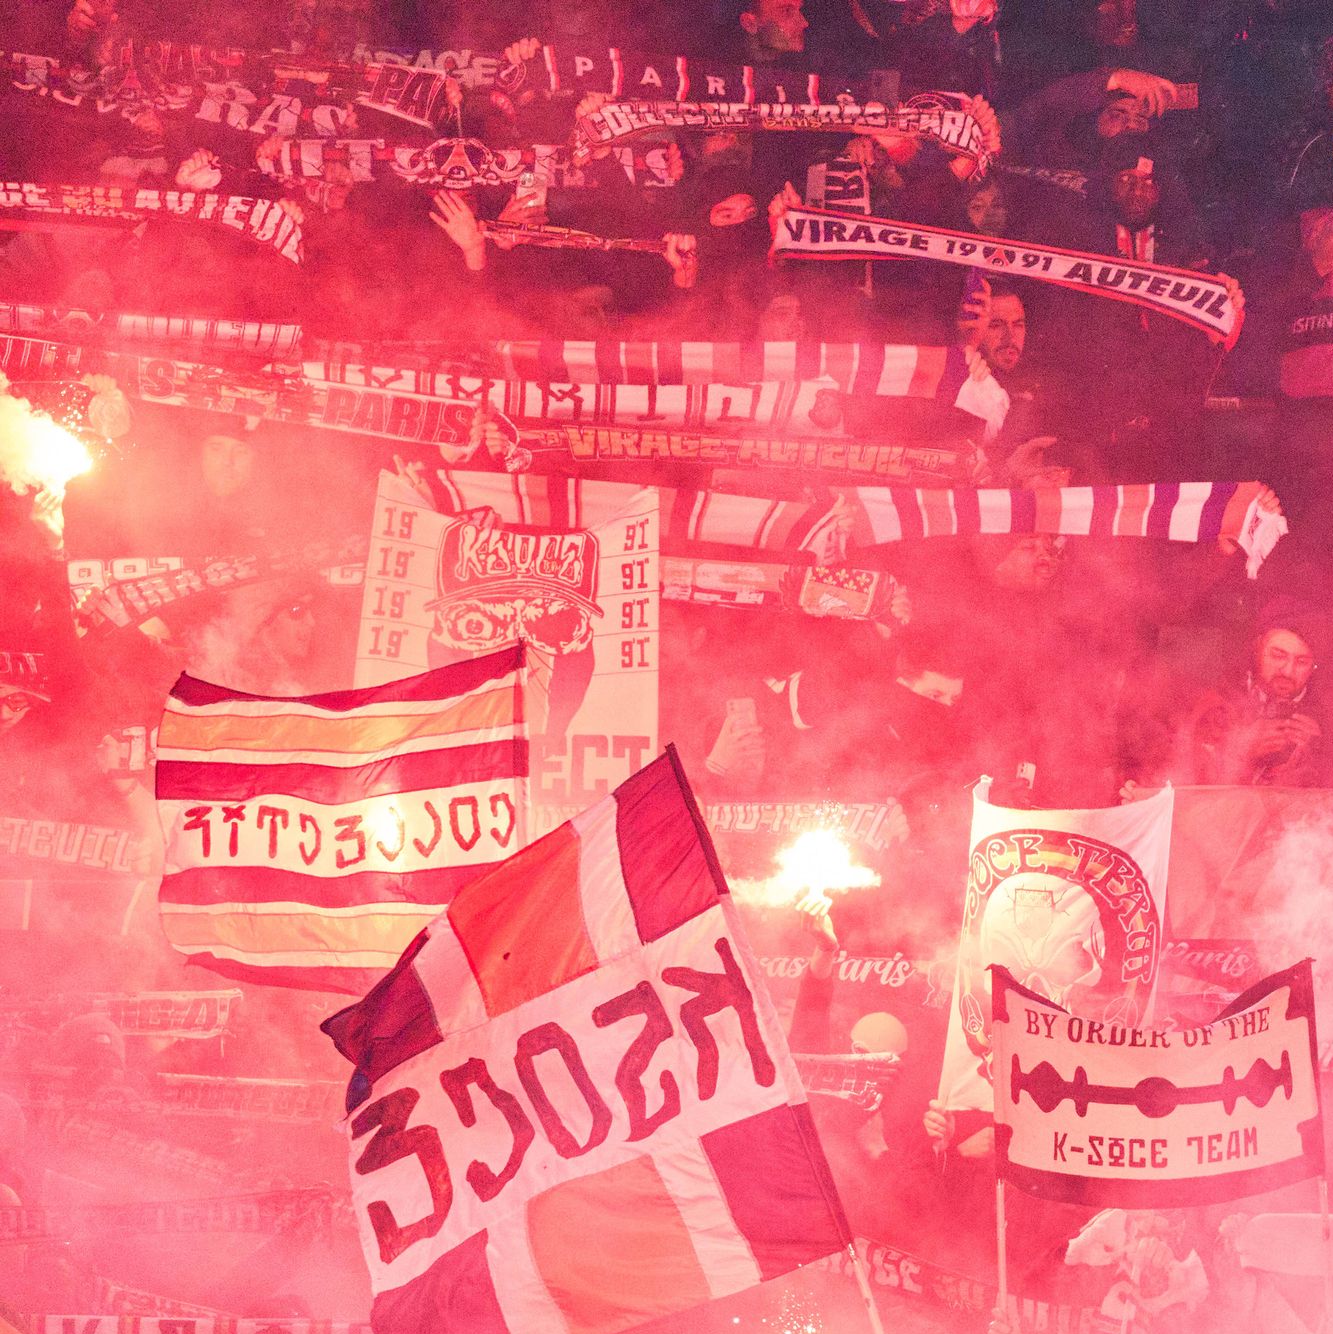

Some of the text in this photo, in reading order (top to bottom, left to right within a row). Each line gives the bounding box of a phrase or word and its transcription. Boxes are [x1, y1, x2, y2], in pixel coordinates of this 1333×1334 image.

[786, 209, 1230, 320] VIRAGE 19 91 AUTEUIL
[322, 385, 475, 445] PARIS
[567, 428, 728, 460] VIRAGE
[1024, 1007, 1058, 1040] BY
[1067, 1014, 1172, 1050] ORDER
[1216, 1006, 1271, 1040] THE
[1052, 1126, 1259, 1169] K-SOCE TEAM
